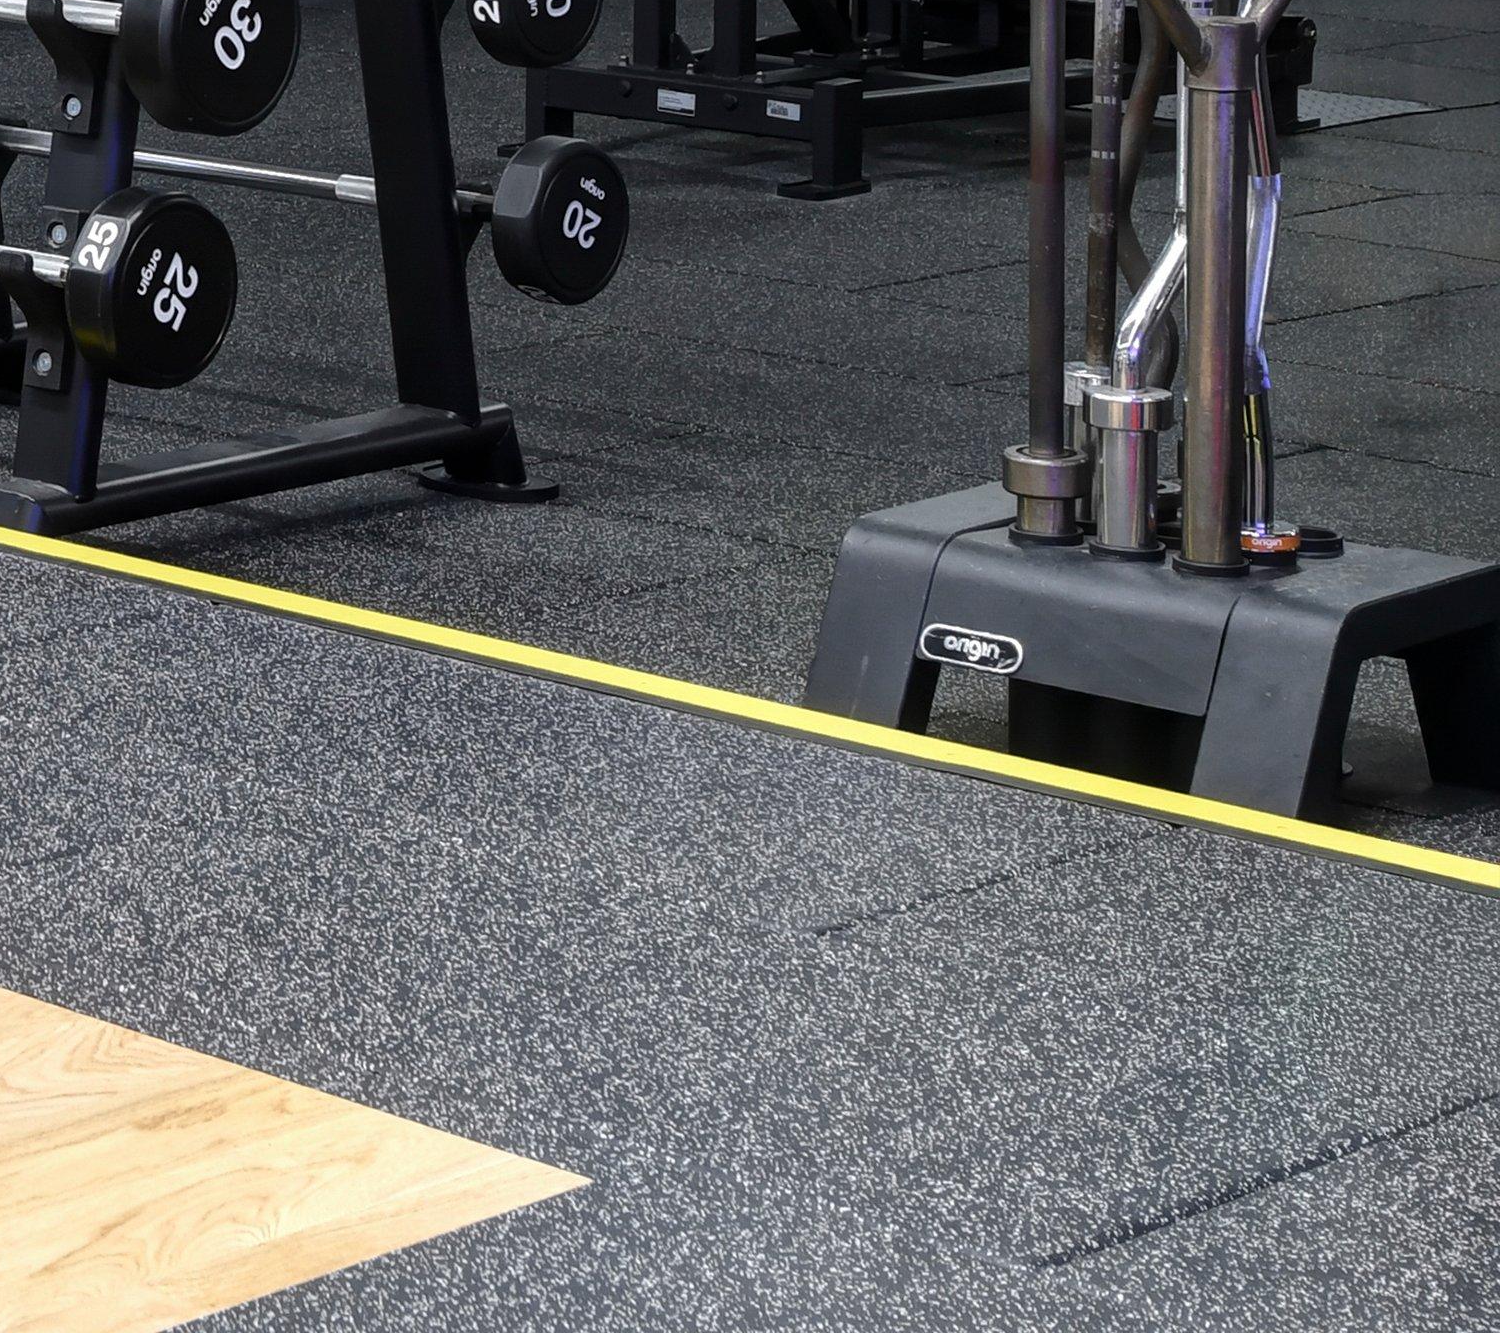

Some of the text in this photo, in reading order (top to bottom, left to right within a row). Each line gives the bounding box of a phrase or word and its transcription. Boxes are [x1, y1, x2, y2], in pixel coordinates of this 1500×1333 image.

[579, 176, 606, 201] origin
[77, 219, 120, 271] 25
[562, 199, 602, 250] 20
[136, 247, 163, 297] origin
[152, 252, 200, 333] 25
[1251, 538, 1283, 549] origin
[943, 635, 1001, 662] origin
